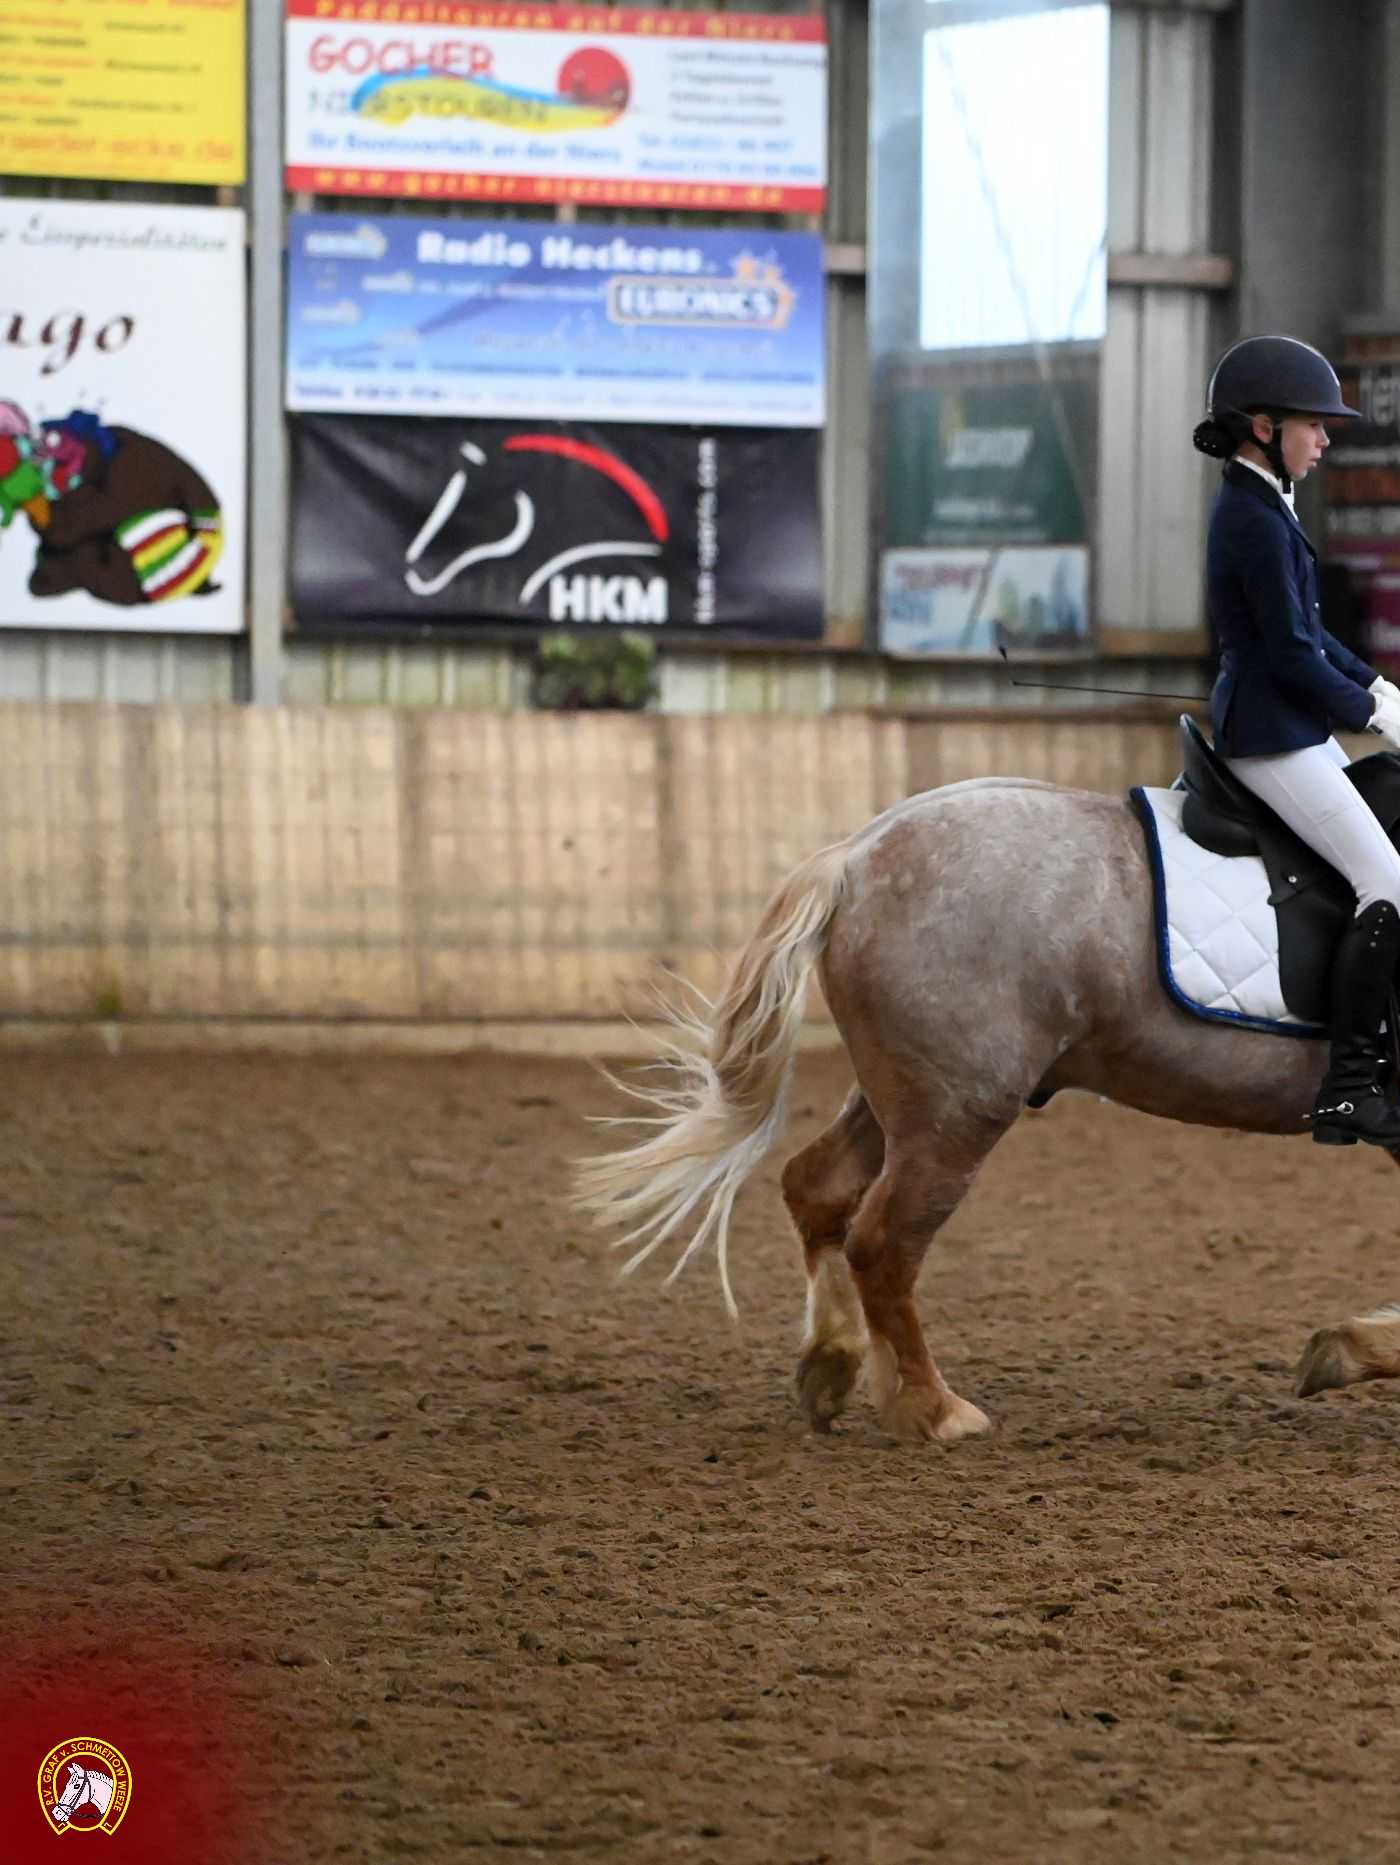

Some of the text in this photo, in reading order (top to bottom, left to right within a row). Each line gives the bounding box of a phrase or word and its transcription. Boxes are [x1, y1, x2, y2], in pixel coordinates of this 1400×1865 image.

[308, 35, 496, 77] GOCHER
[416, 230, 532, 269] Radio
[541, 236, 703, 275] Heckens
[549, 576, 668, 624] HKM
